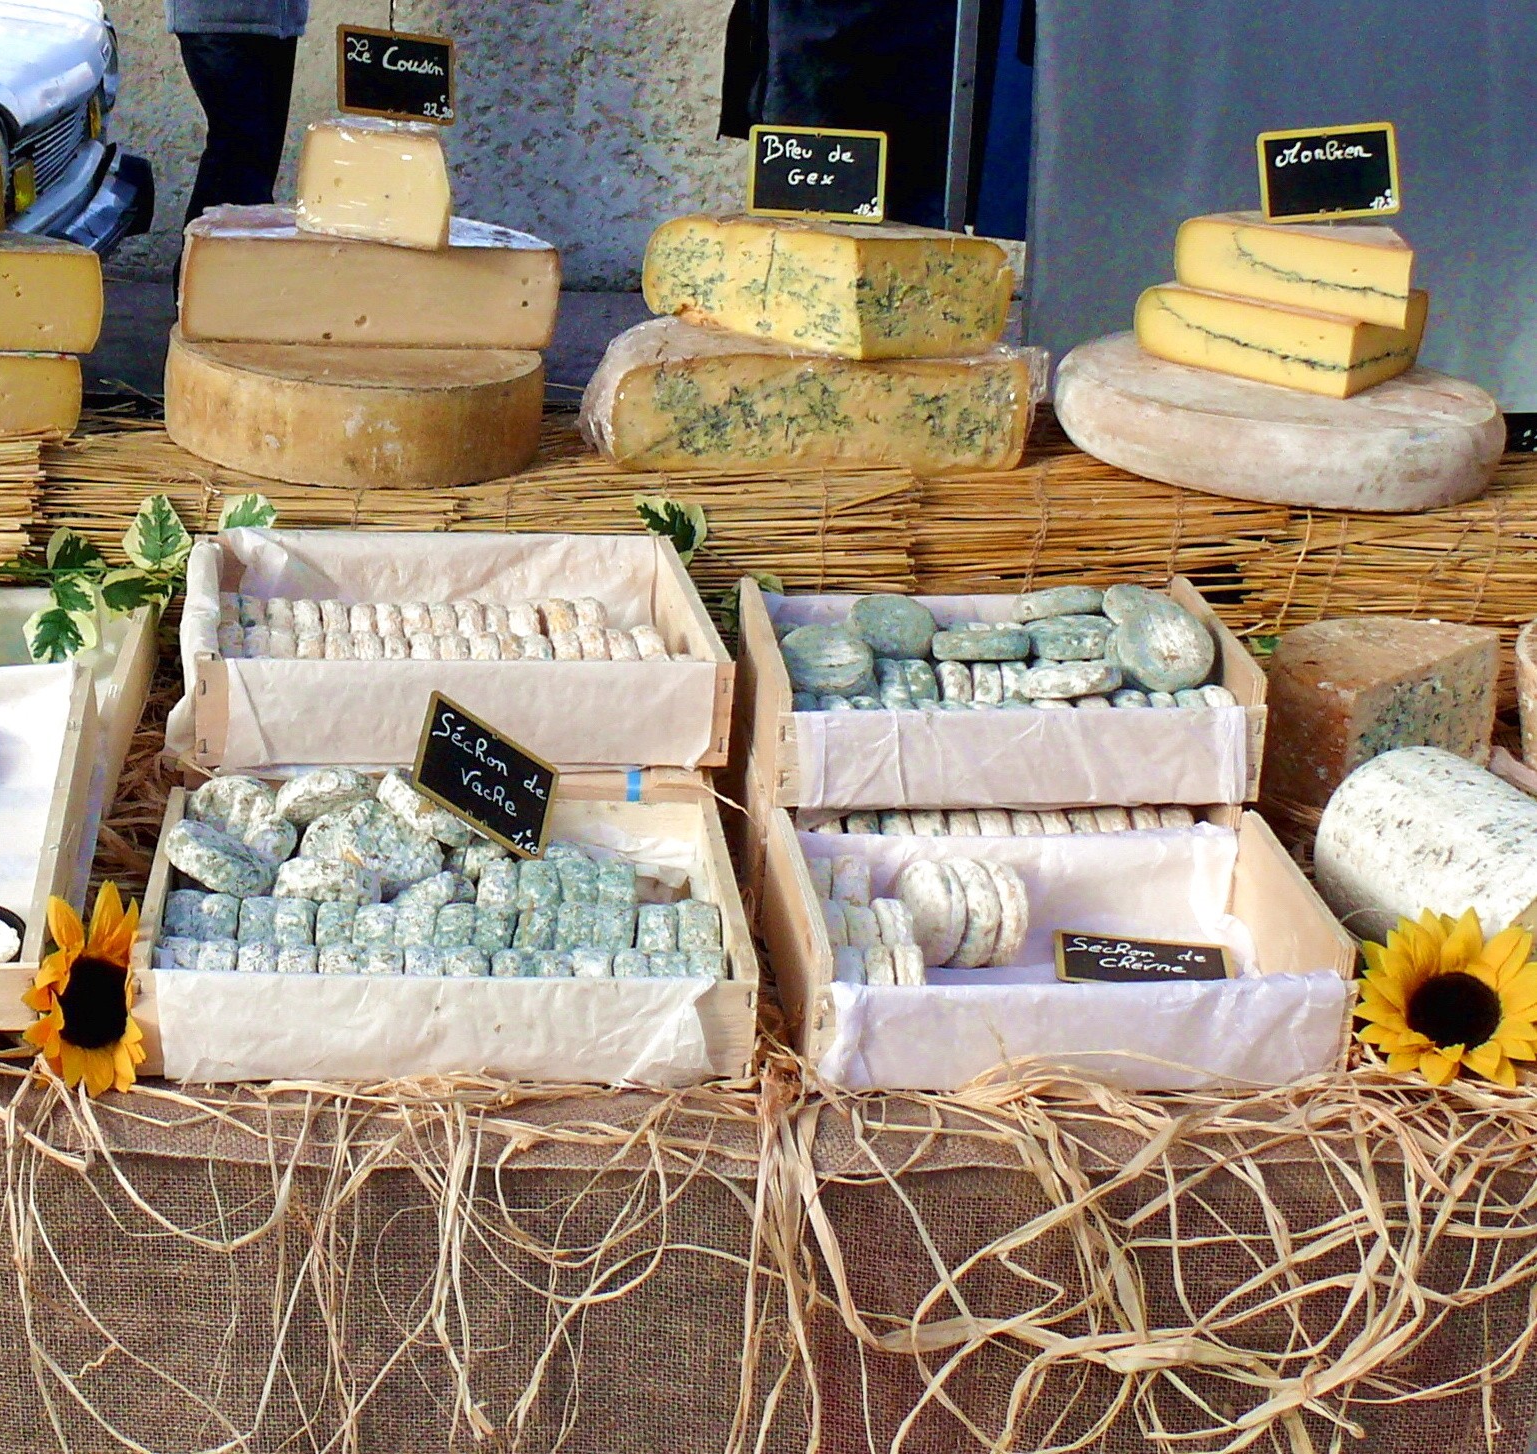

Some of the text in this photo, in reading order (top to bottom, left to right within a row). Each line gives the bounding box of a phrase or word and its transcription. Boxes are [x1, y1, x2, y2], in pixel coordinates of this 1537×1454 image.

[345, 36, 445, 76] Le Cousin
[762, 134, 855, 164] Bleu de
[1275, 140, 1373, 168] Morbier
[787, 168, 836, 185] Gex
[432, 712, 548, 800] Séchon de
[461, 767, 518, 818] Vache
[1177, 950, 1207, 963] de
